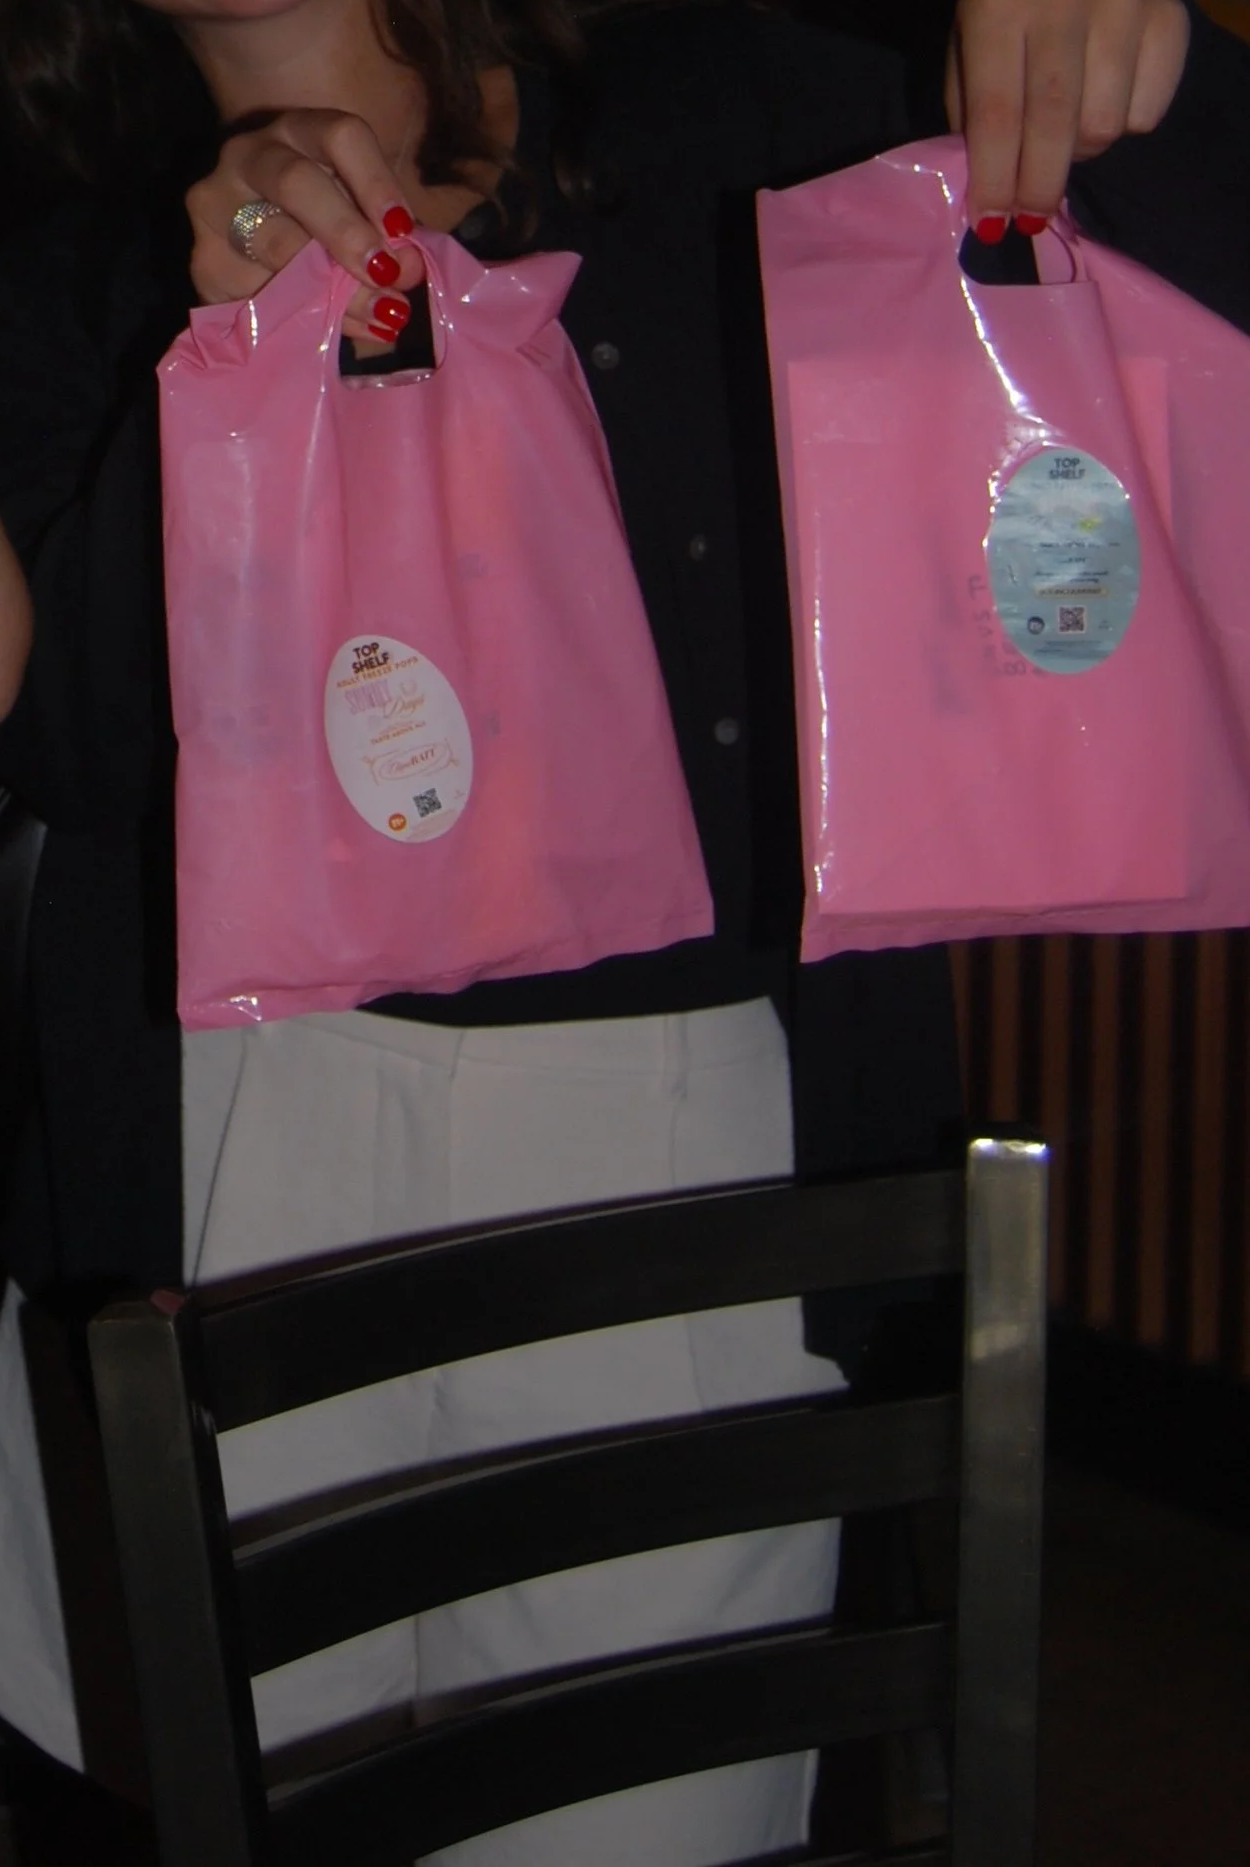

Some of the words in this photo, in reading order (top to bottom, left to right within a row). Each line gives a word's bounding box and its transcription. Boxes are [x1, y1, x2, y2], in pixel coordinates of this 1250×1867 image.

[1054, 457, 1081, 469] TOP
[1049, 468, 1086, 480] SHELF
[352, 642, 380, 660] TOP
[352, 652, 391, 674] SHELF
